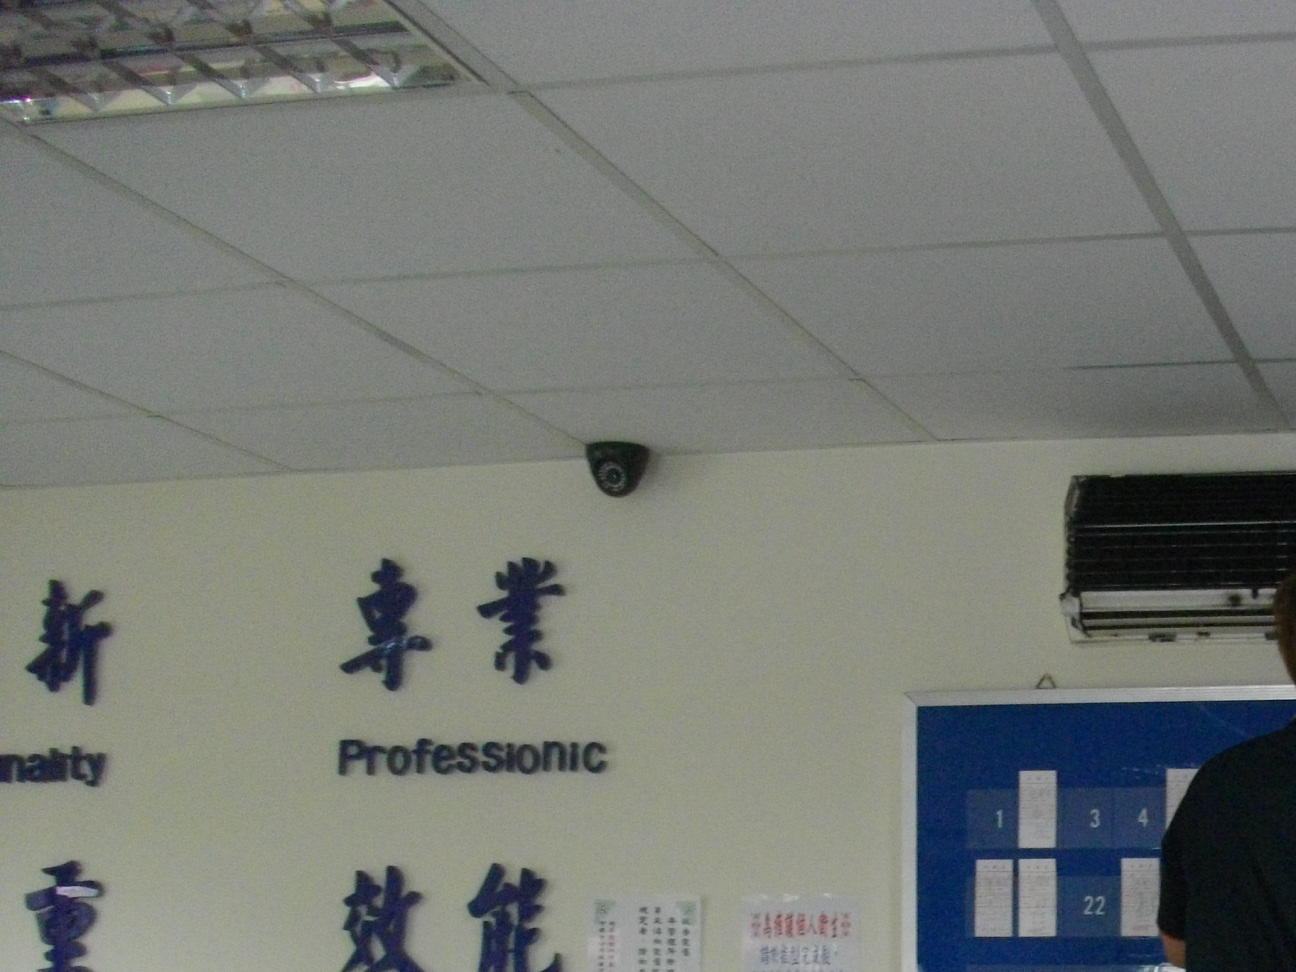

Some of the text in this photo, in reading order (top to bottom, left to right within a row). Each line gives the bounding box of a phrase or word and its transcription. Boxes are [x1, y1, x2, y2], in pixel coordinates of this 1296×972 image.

[25, 579, 113, 705] 新
[339, 557, 566, 691] 專業
[338, 738, 608, 776] Professionic
[994, 808, 1005, 830] 1
[1088, 807, 1102, 830] 3
[1136, 807, 1150, 828] 4
[1081, 894, 1107, 917] 22
